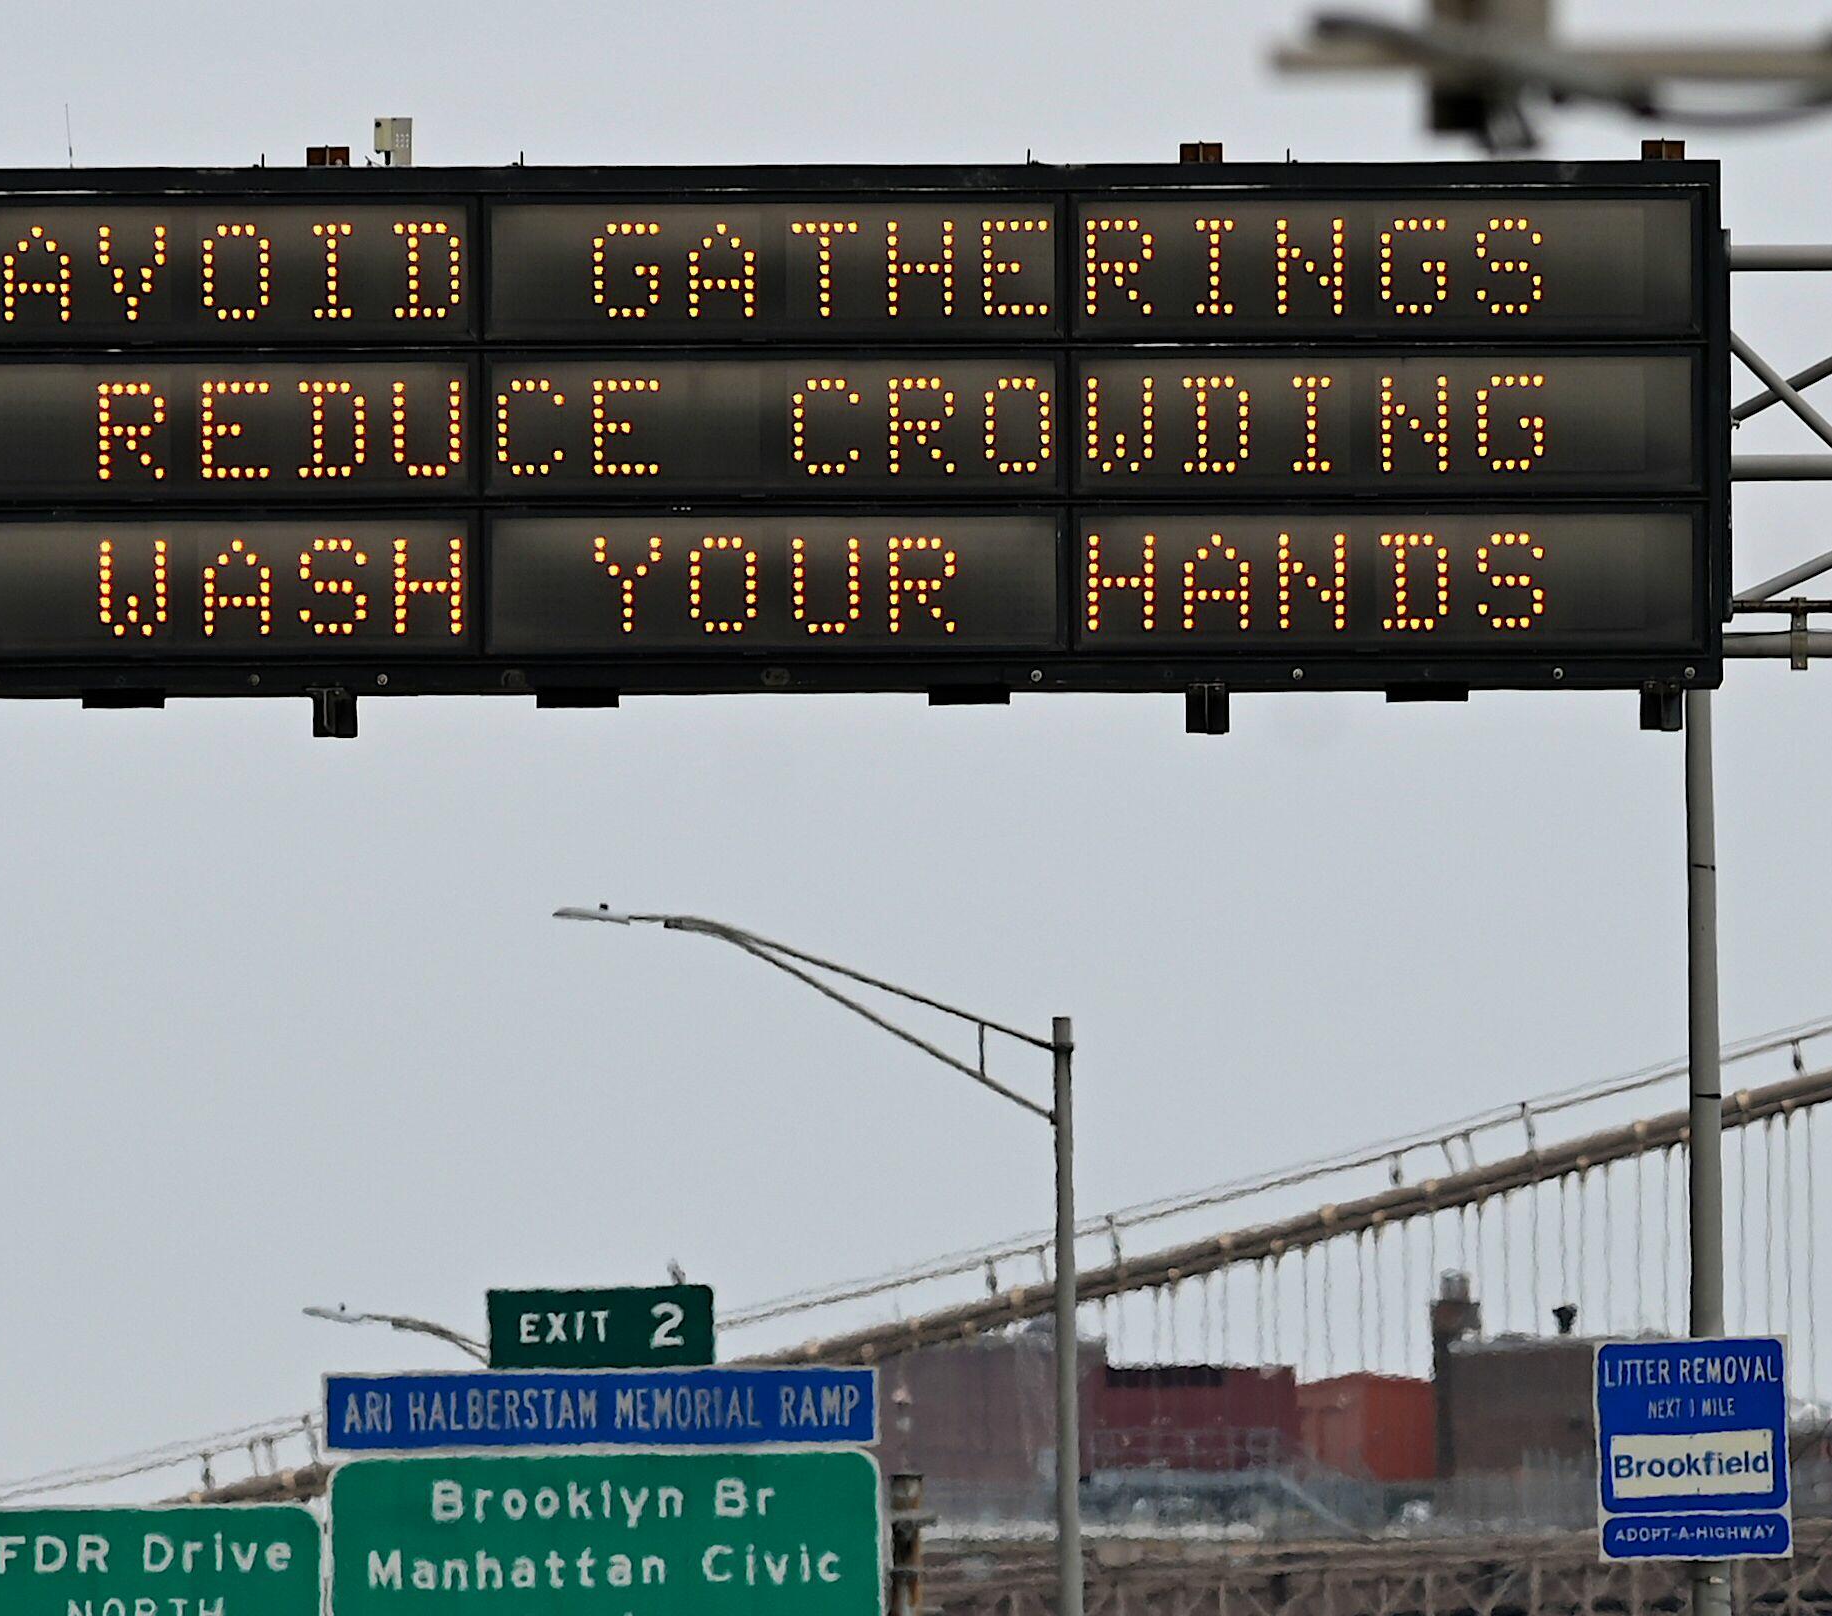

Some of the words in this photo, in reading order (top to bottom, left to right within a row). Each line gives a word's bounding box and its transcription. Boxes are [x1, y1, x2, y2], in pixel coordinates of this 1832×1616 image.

[4, 223, 459, 321] AVOID
[594, 219, 1541, 317] GATHERINGS
[98, 380, 659, 479] REDUCE
[793, 375, 1543, 474] CROWDING
[99, 539, 462, 636] WASH
[594, 537, 955, 633] YOUR
[1088, 533, 1543, 630] HANDS
[520, 1311, 608, 1343] EXIT
[651, 1303, 683, 1346] 2
[1605, 1359, 1671, 1387] LITTER
[1680, 1354, 1779, 1384] REMOVAL
[344, 1392, 391, 1433] ARI
[409, 1390, 596, 1430] HALBERSTAM
[615, 1388, 759, 1429] MEMORIAL
[781, 1385, 859, 1426] RAMP
[1649, 1399, 1680, 1418] NEXT
[1689, 1398, 1695, 1418] 1
[1702, 1398, 1734, 1416] MILE
[1615, 1451, 1769, 1478] Brookfield
[433, 1480, 683, 1527] Brooklyn
[715, 1479, 774, 1517] Br
[144, 1533, 291, 1572] Drive
[1614, 1524, 1775, 1542] ADOPT-A-HIGHWAY
[369, 1547, 665, 1590] Manhattan
[702, 1545, 839, 1585] Civic
